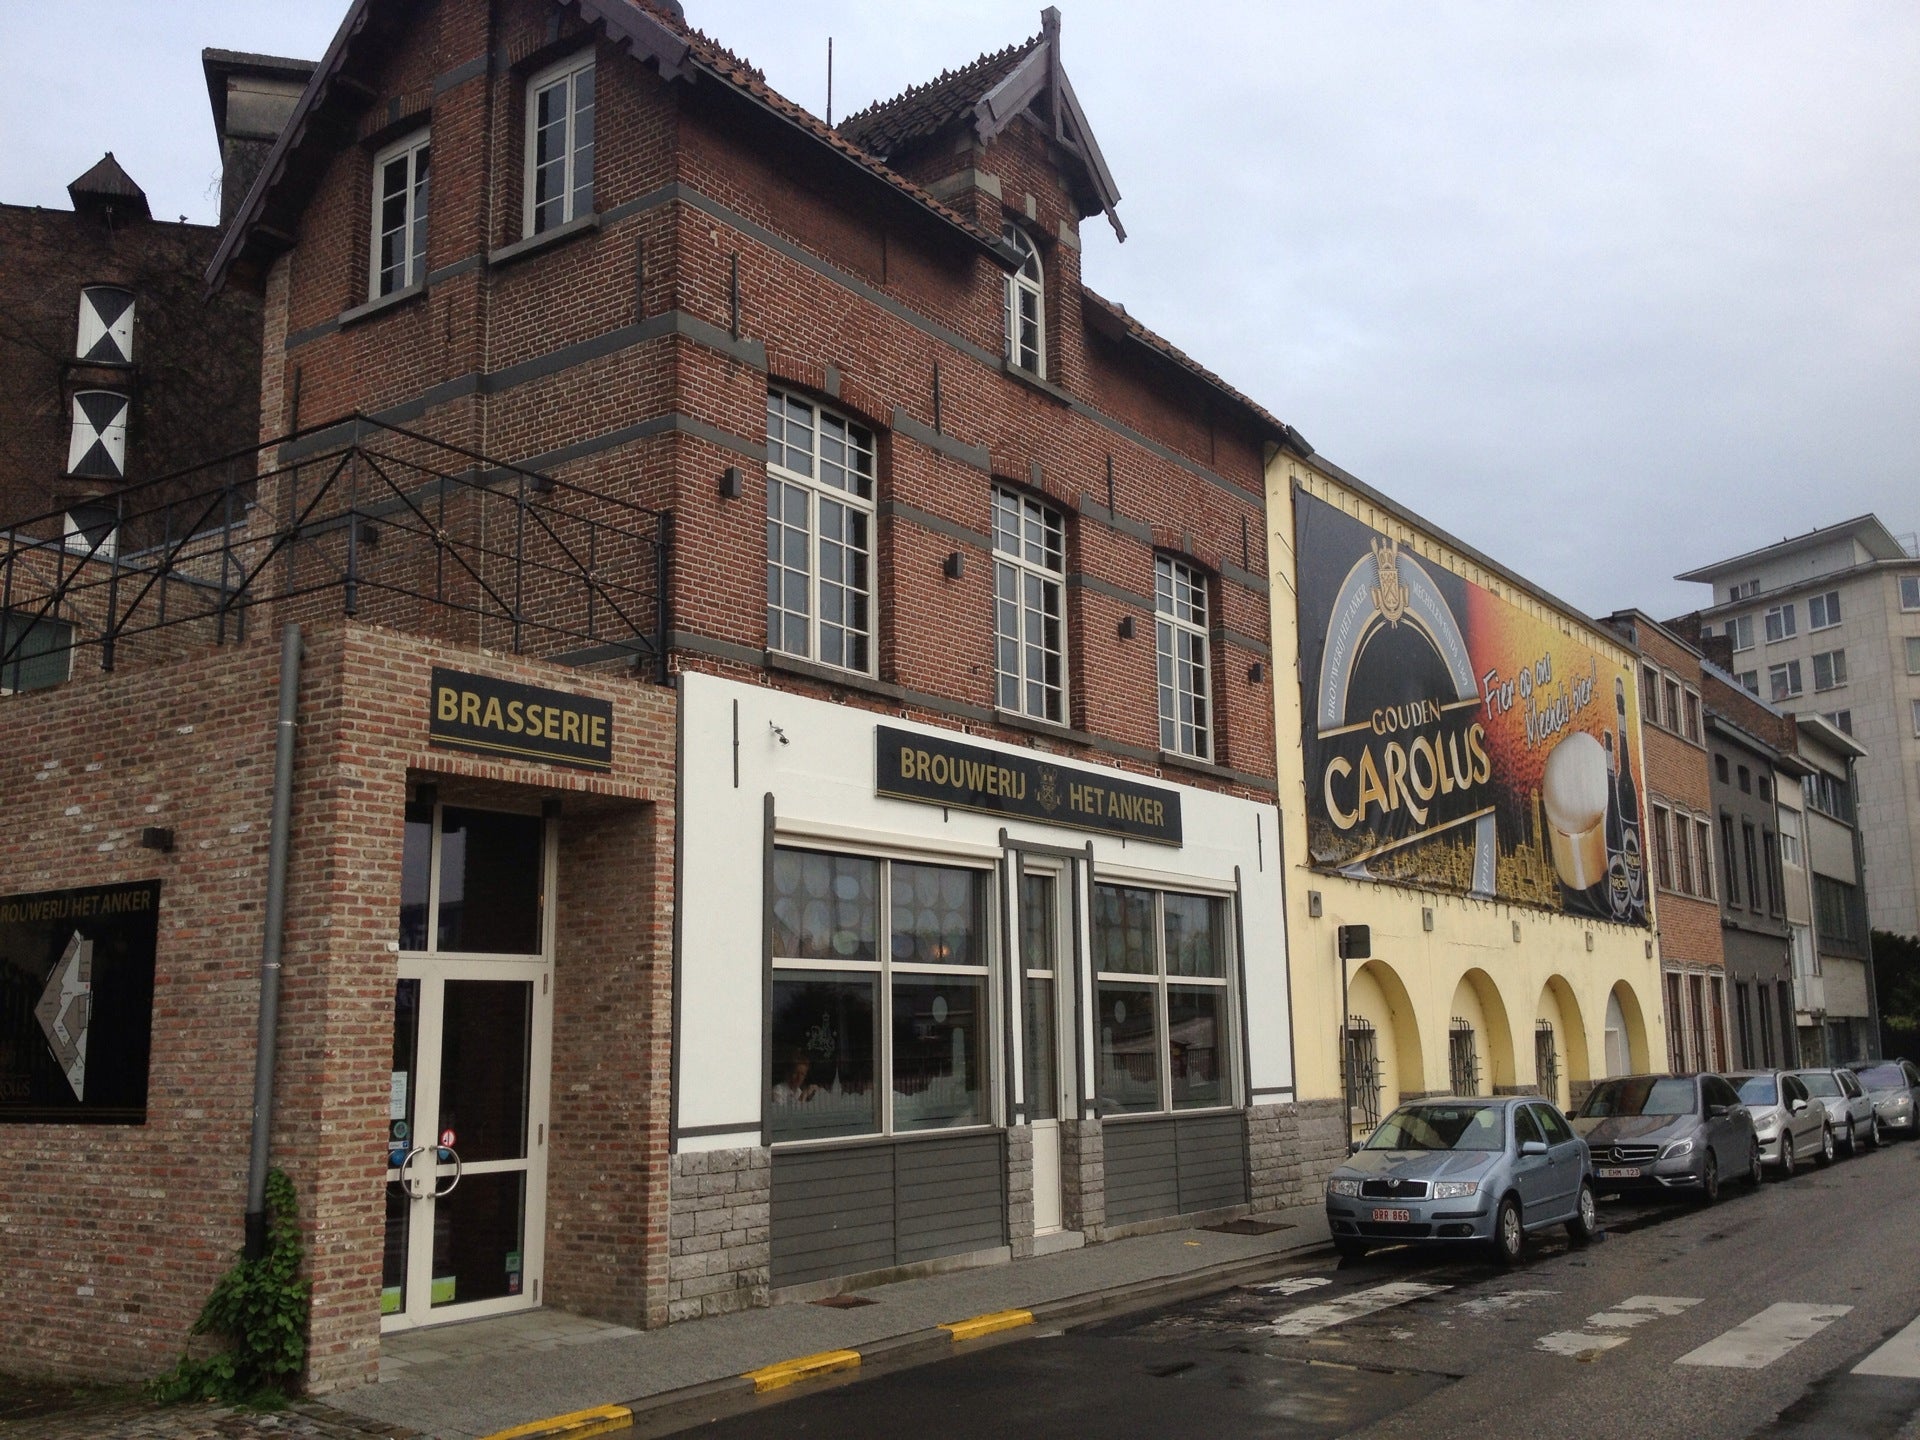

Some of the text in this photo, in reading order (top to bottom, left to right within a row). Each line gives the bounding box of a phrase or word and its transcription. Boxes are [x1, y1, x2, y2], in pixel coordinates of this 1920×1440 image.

[1327, 583, 1368, 721] BROUWERIJ HET ANKER
[1482, 651, 1552, 721] Fier op ons
[437, 686, 606, 748] BRASSERIE
[1372, 698, 1441, 736] GOUDEN
[1524, 655, 1600, 751] Mechels bier!
[900, 746, 1165, 827] BROUWERIJ HET ANKER
[1324, 723, 1491, 830] CAROLUS
[0, 890, 151, 924] ROUWERIJ HET ANKER
